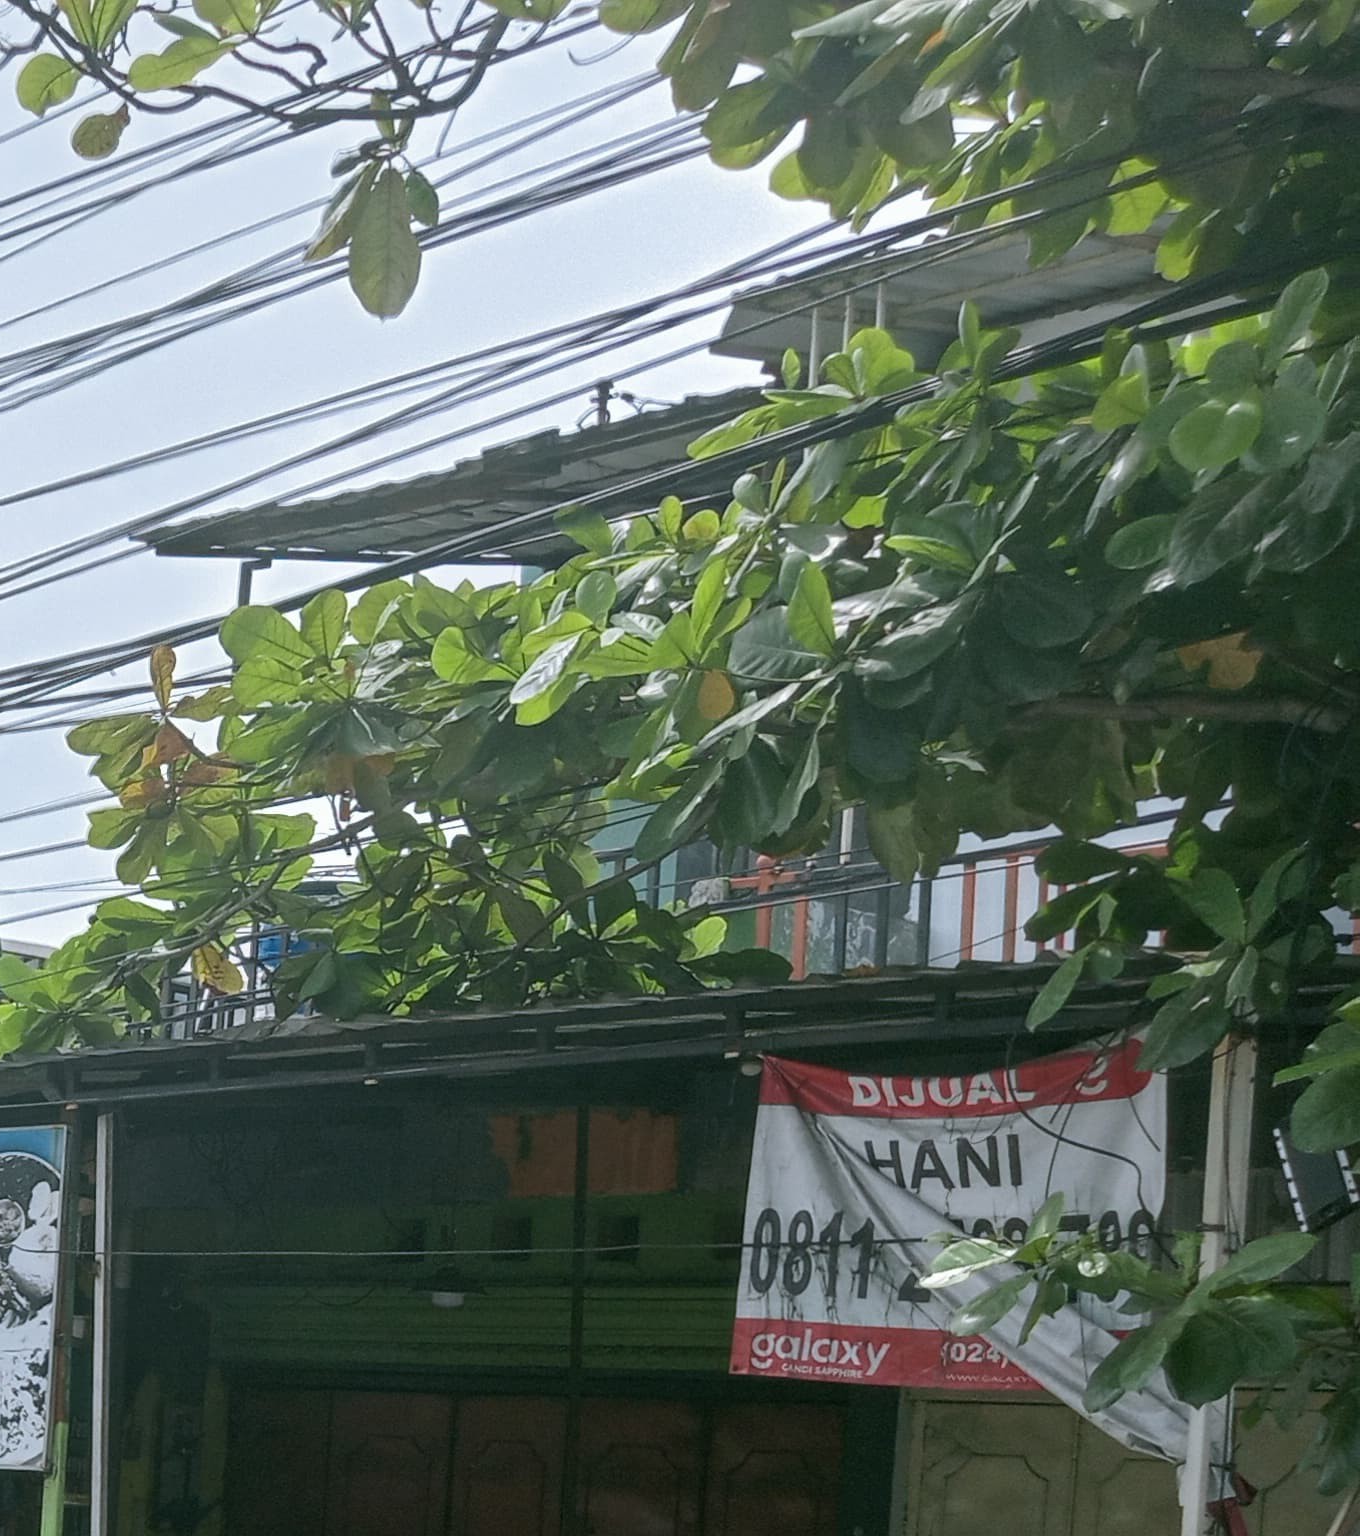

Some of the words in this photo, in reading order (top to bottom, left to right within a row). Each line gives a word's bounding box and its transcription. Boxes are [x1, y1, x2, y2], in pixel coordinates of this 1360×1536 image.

[847, 1069, 1037, 1108] DIJUAL
[864, 1133, 1024, 1190] HANI
[750, 1328, 891, 1376] galaxy
